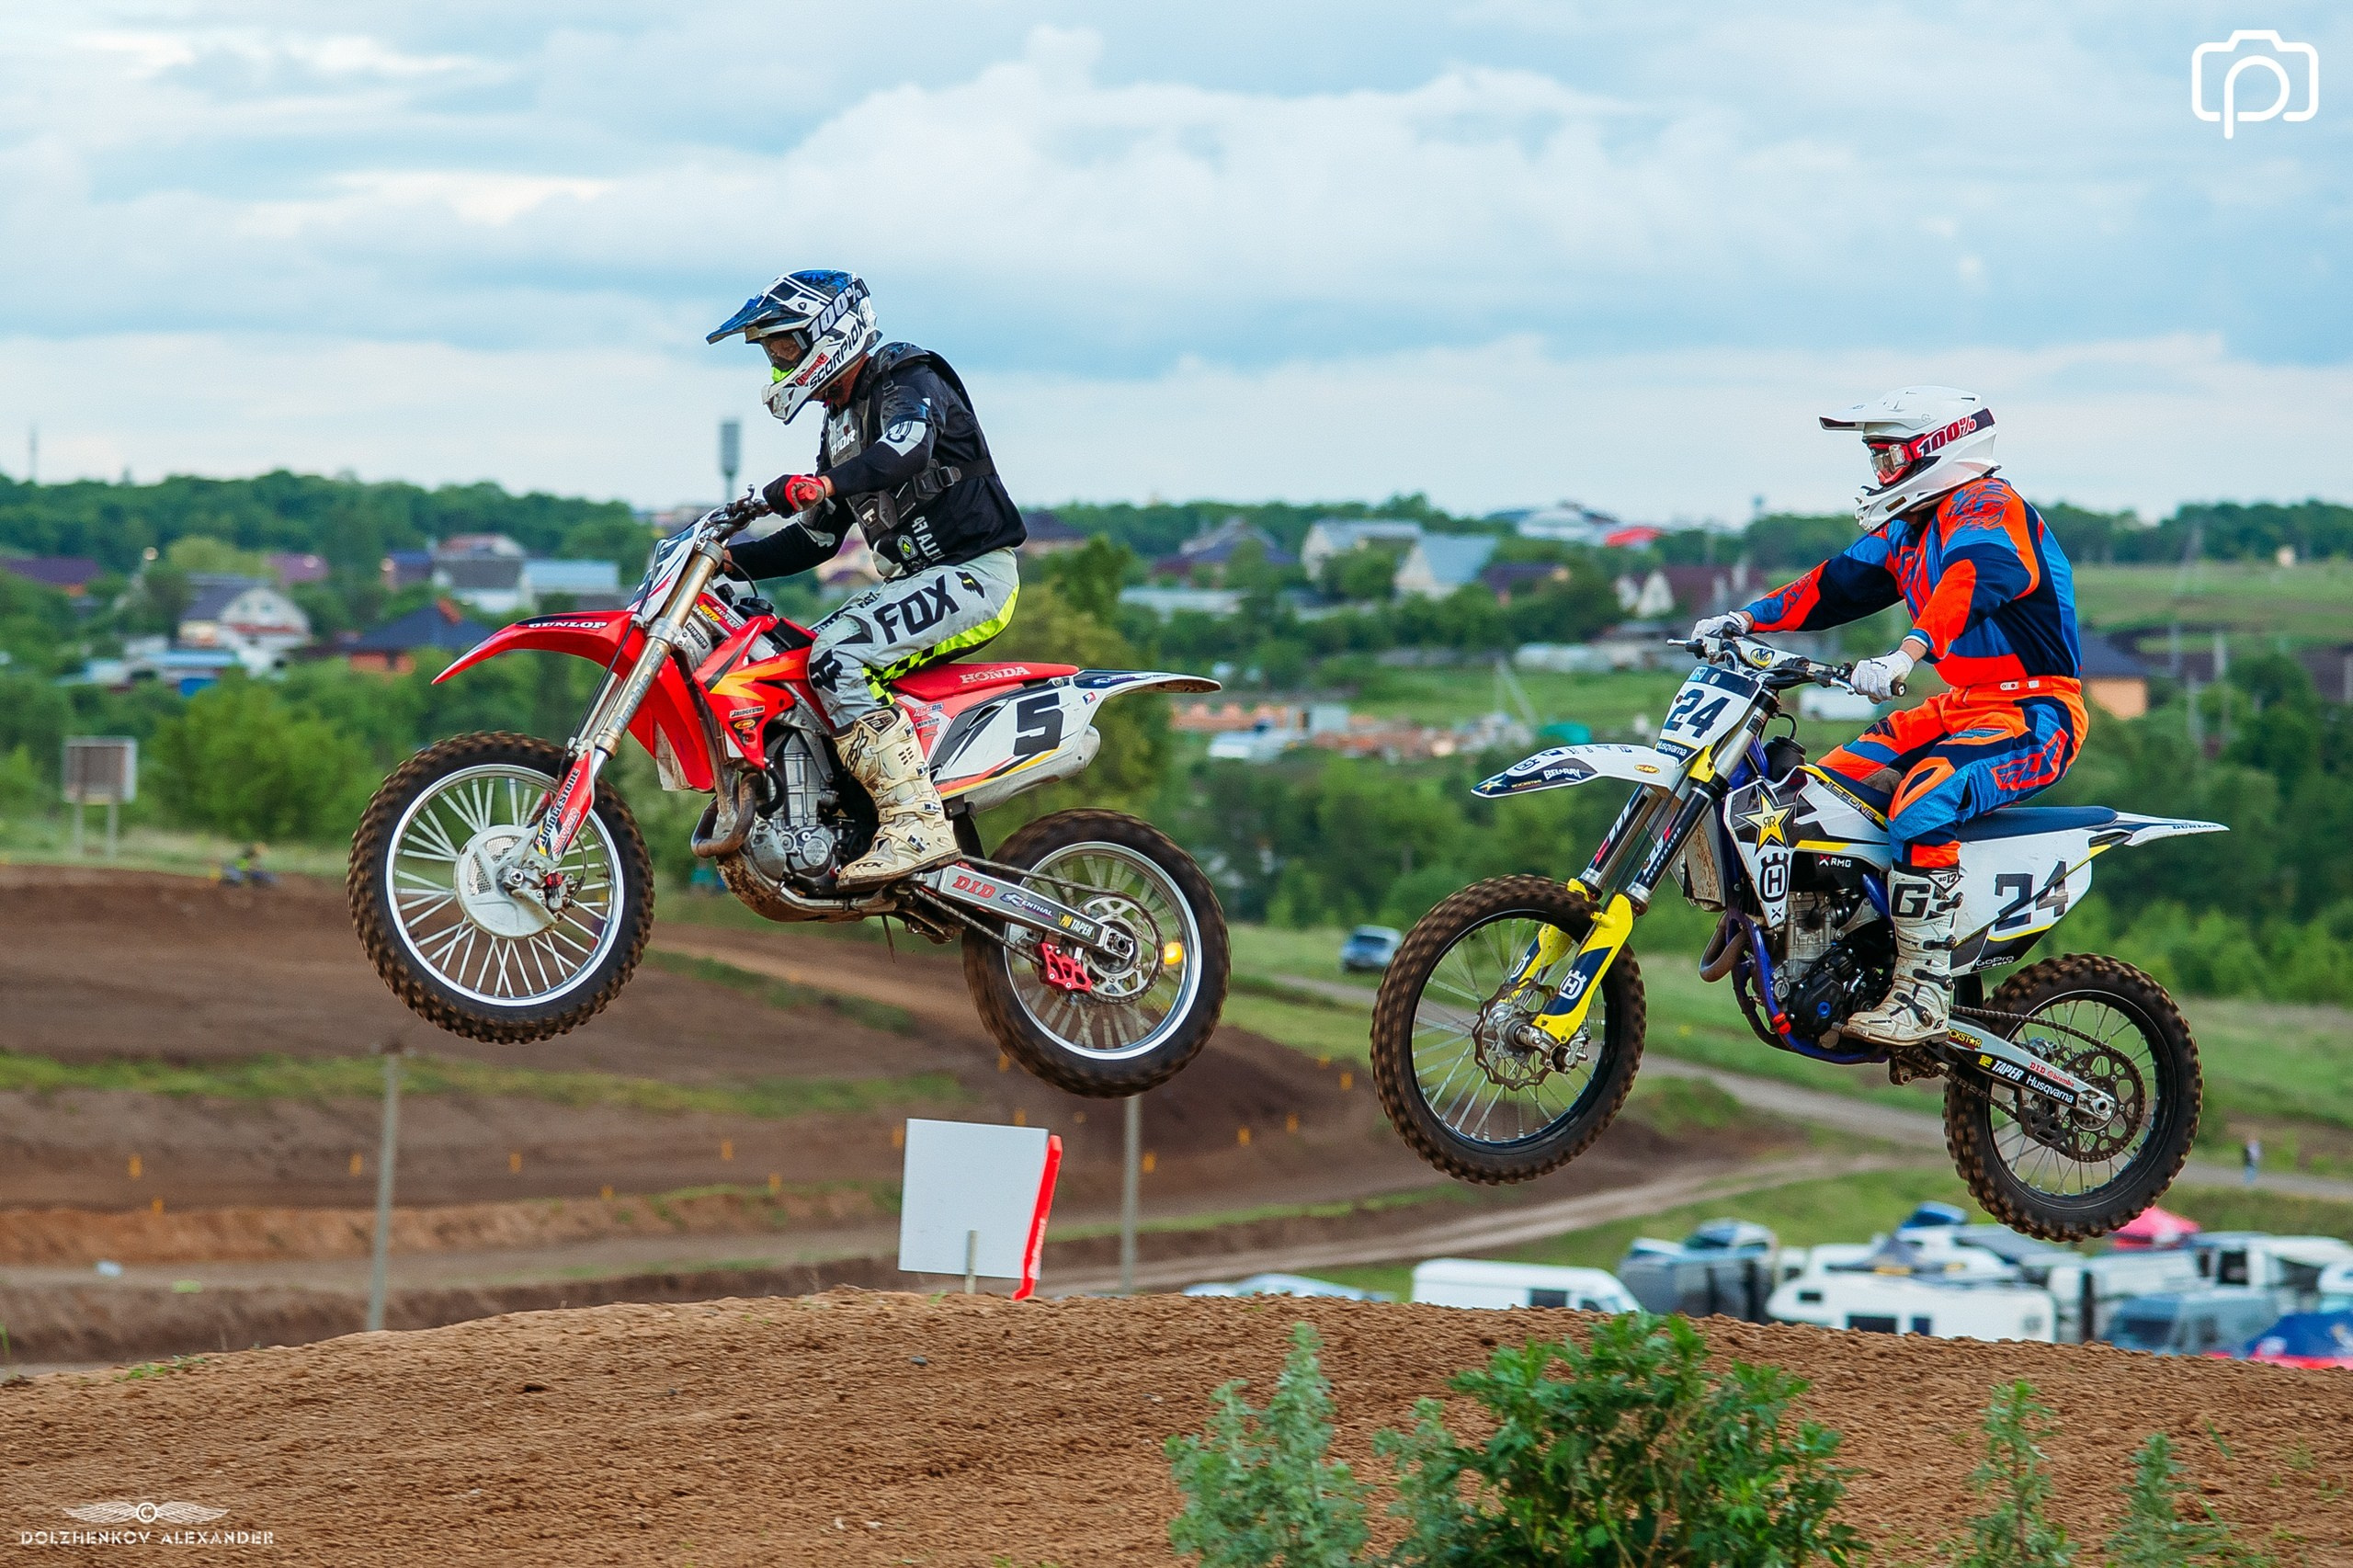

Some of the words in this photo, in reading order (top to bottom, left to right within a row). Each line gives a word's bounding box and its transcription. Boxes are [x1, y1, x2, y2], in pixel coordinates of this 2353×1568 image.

[807, 283, 862, 342] 100%
[810, 309, 868, 390] SCORPION
[1916, 415, 1977, 456] 100%
[872, 574, 961, 644] FOX
[959, 666, 1031, 684] HONDA
[1013, 691, 1064, 756] 5
[1663, 688, 1731, 739] 24
[1656, 740, 1688, 756] Husqvarna
[539, 768, 580, 845] BRIDGESTONE
[1994, 860, 2068, 932] 24
[1070, 921, 1095, 937] TAPER
[1976, 956, 2014, 966] GoPro
[1991, 1060, 2024, 1081] TAPER
[2026, 1074, 2075, 1104] Husqvarna
